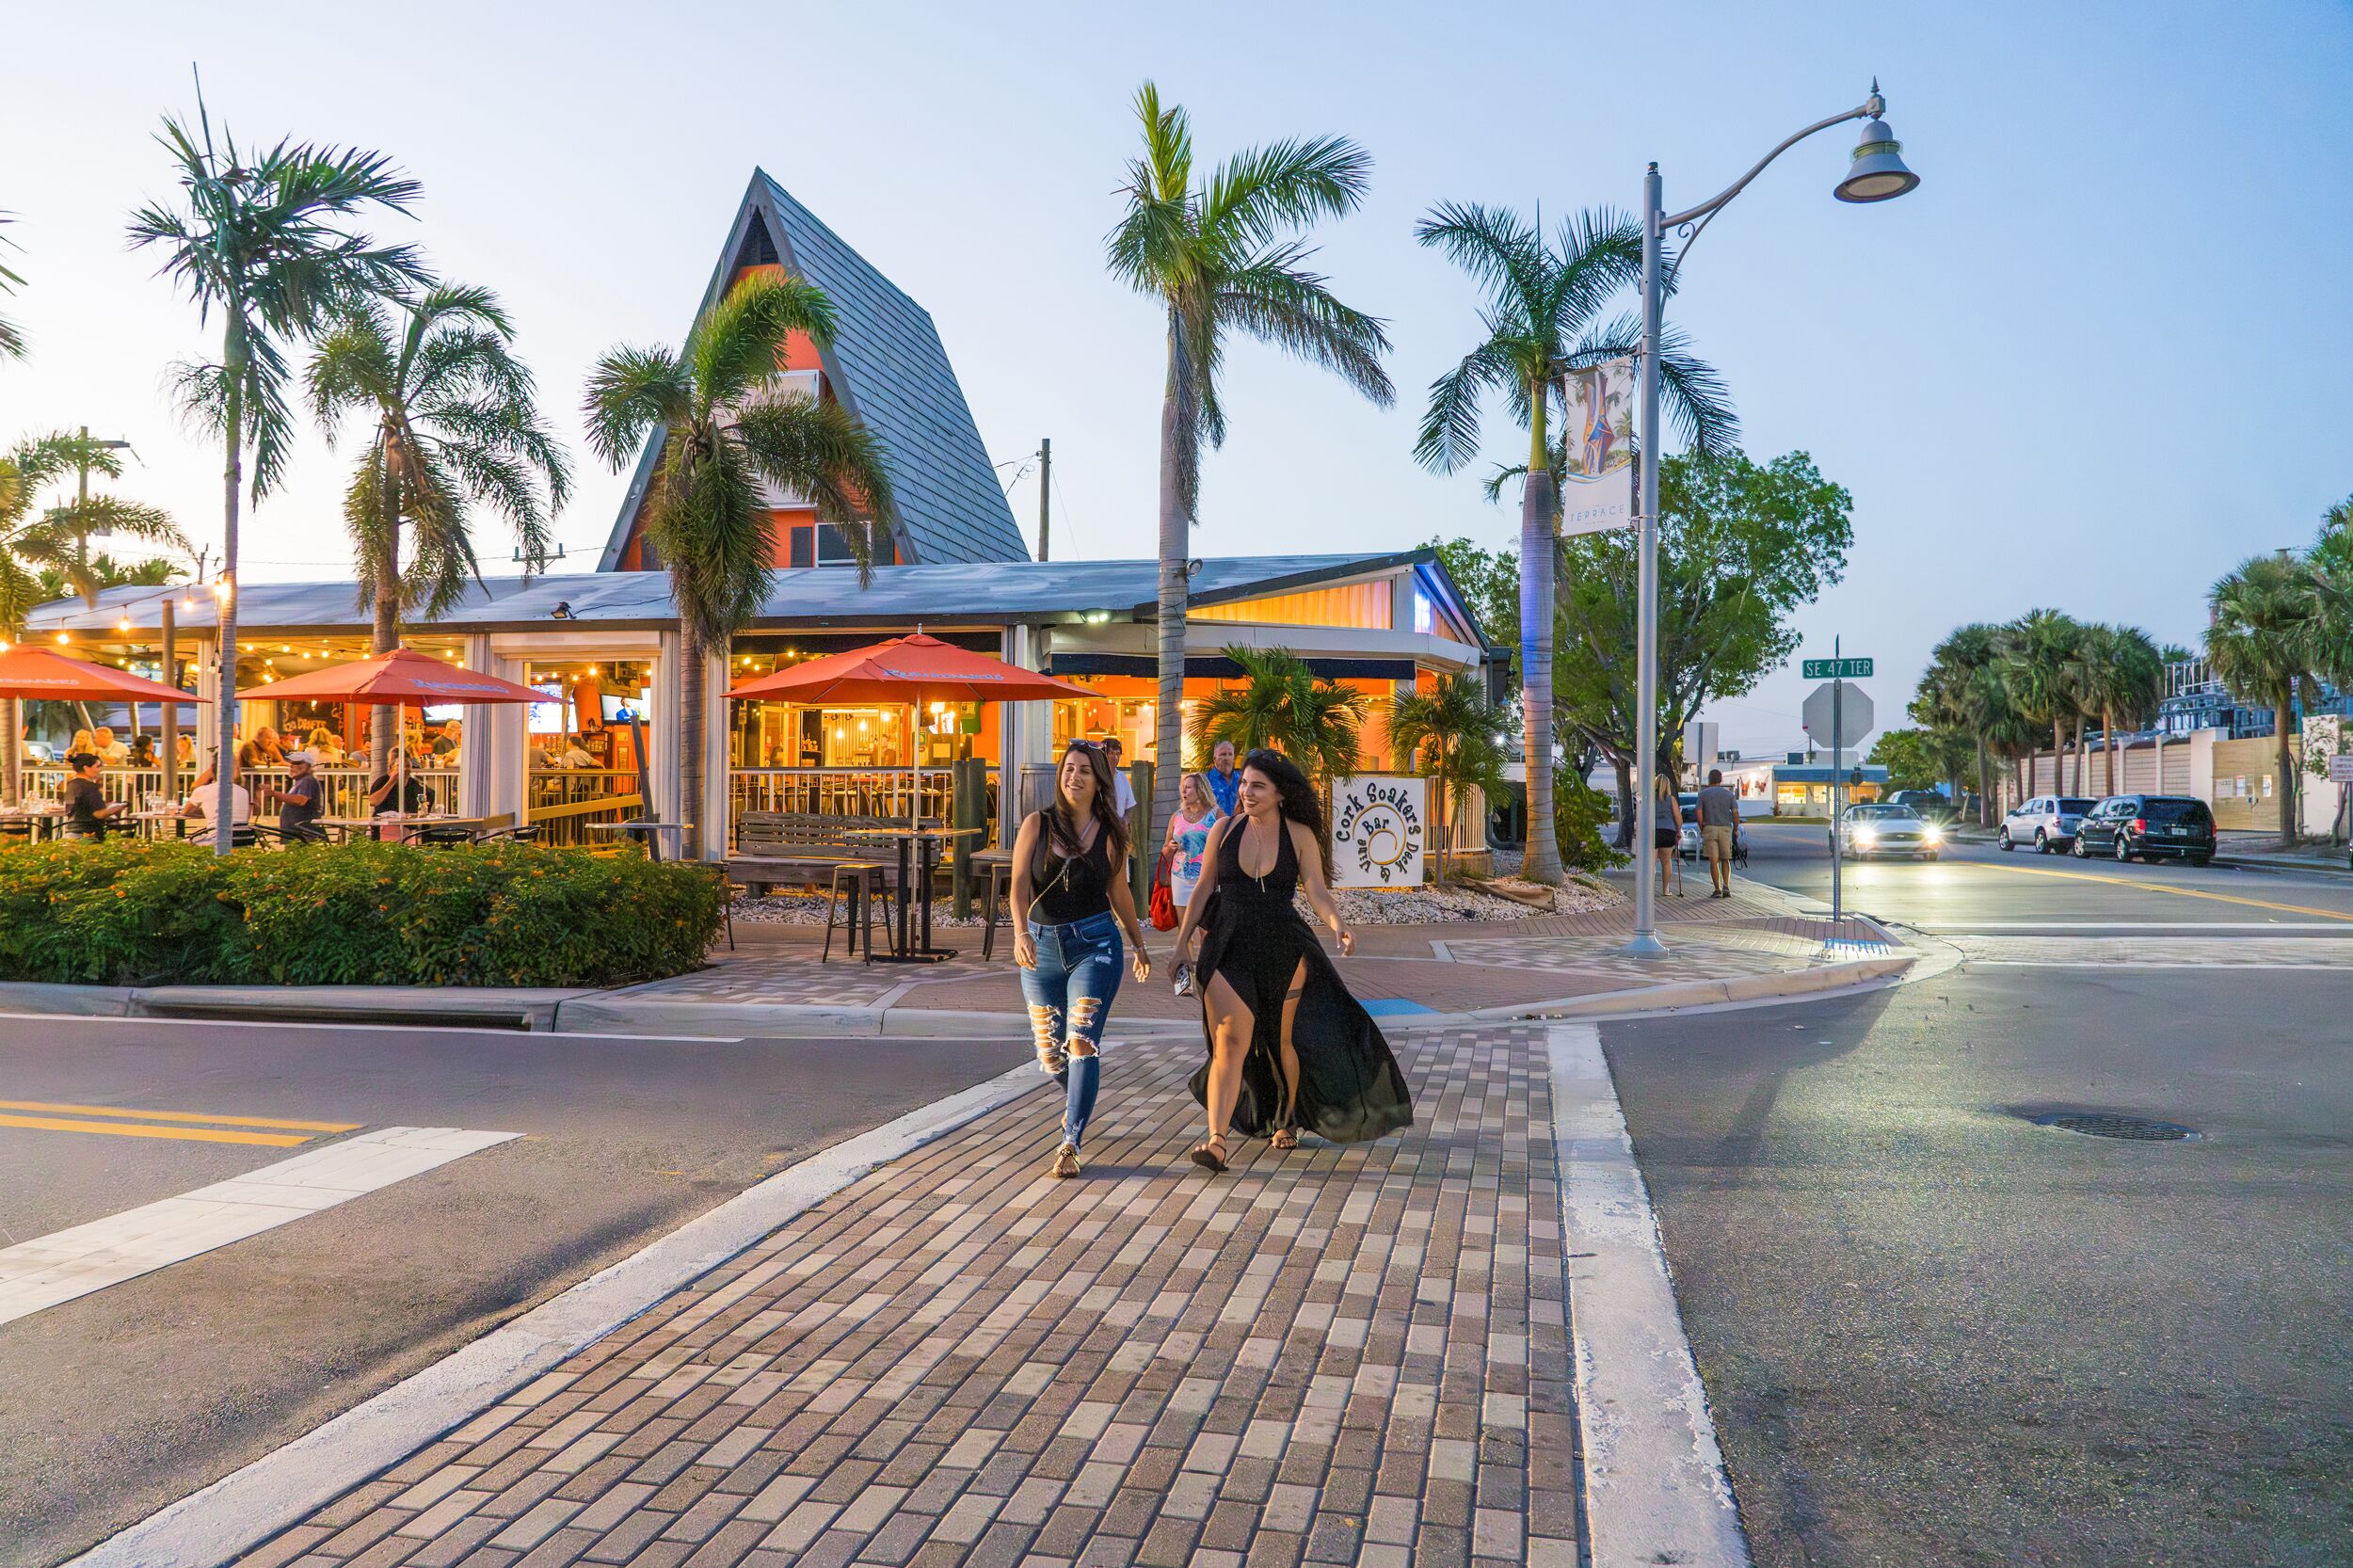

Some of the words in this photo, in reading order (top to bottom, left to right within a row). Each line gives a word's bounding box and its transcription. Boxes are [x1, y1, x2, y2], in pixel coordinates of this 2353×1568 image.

[1570, 504, 1625, 521] TERRACE
[1806, 662, 1821, 677] SE
[1827, 661, 1844, 676] 47
[1849, 660, 1871, 675] TER
[1336, 793, 1365, 842] Cork
[1367, 782, 1422, 836] Soakers
[1362, 817, 1390, 837] Bar
[1357, 839, 1371, 873] Vine
[1395, 841, 1419, 874] Deck
